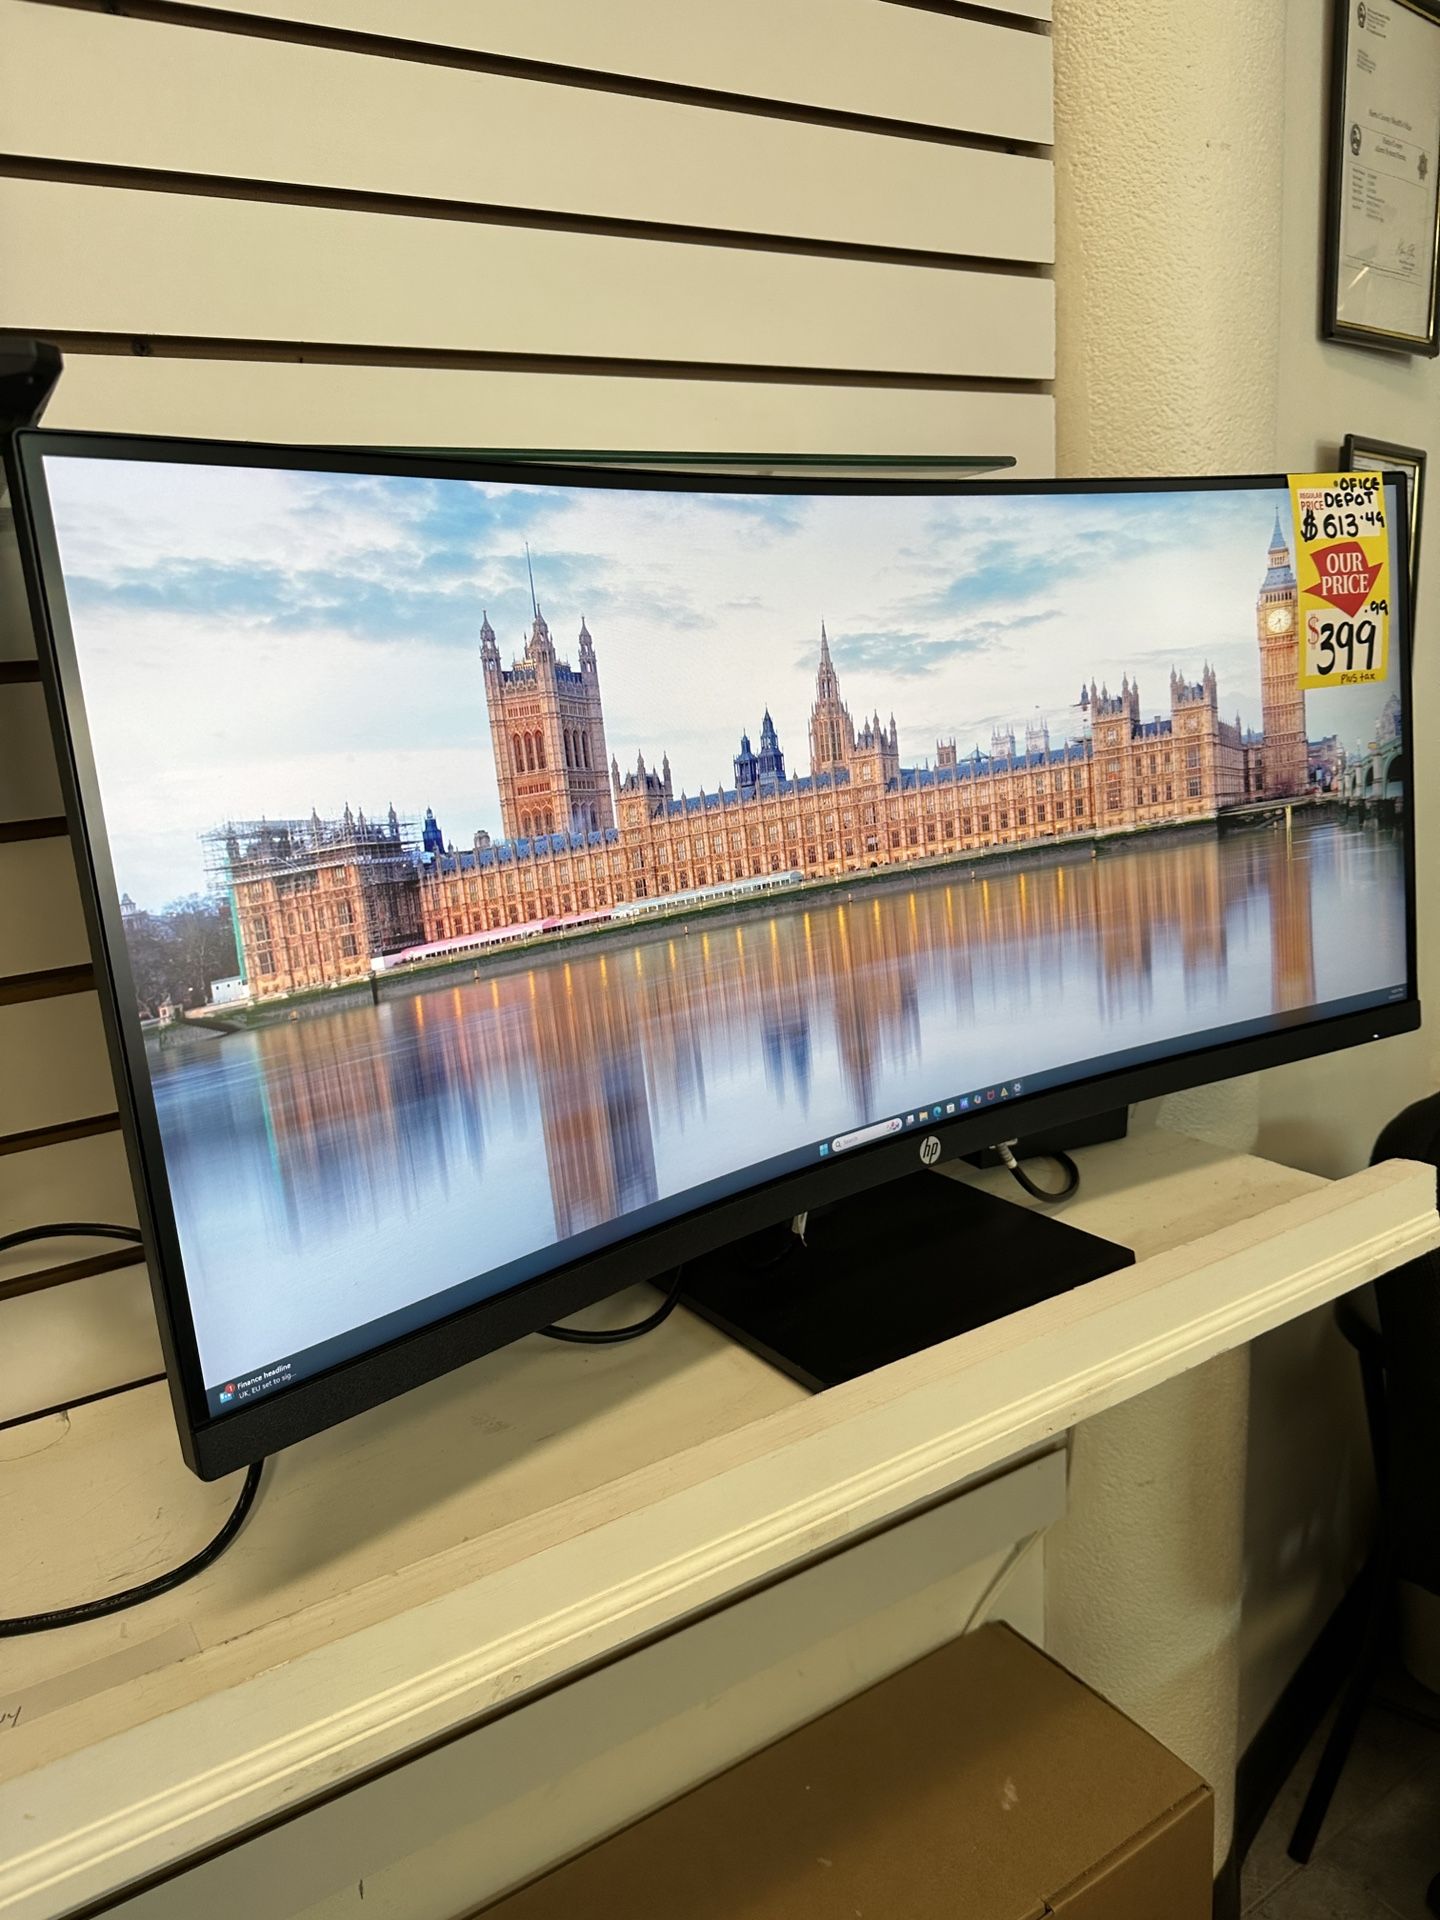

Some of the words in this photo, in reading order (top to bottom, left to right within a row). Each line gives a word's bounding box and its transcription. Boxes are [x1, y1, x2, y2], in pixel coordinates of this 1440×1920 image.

[1300, 500, 1324, 511] PRICE
[1324, 491, 1374, 508] DEPOT
[1326, 552, 1364, 574] OUR
[1321, 574, 1370, 596] PRICE
[920, 1136, 941, 1164] hp
[237, 1375, 263, 1390] Finance
[263, 1363, 292, 1380] headline
[251, 1386, 261, 1394] EU
[262, 1380, 272, 1390] set
[273, 1377, 281, 1385] to
